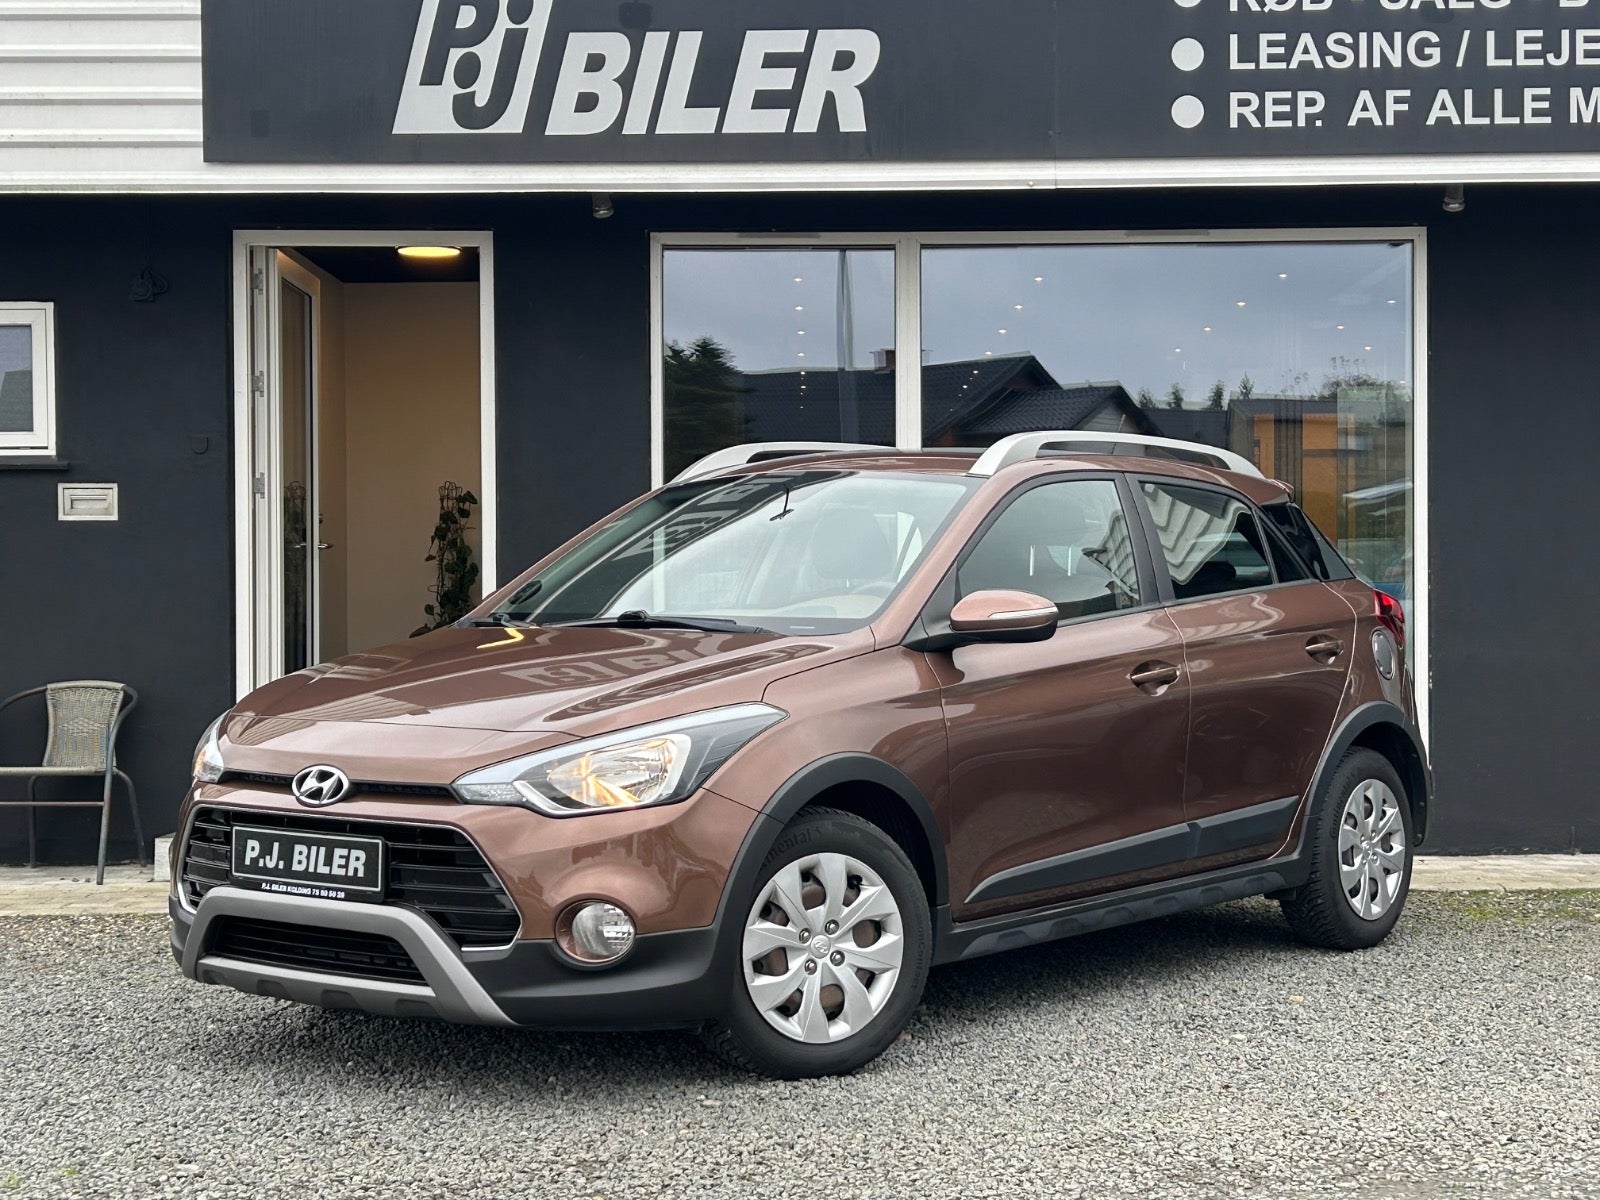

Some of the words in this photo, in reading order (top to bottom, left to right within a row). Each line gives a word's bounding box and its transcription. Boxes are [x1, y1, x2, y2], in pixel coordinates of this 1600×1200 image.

[1229, 30, 1441, 70] LEASING
[1455, 29, 1470, 67] /
[1486, 28, 1600, 67] LEJE
[544, 29, 881, 136] BILER
[1229, 91, 1327, 128] REP.
[1347, 89, 1411, 126] AF
[1425, 87, 1552, 125] ALLE
[244, 839, 284, 869] P.J.
[291, 844, 367, 878] BILER
